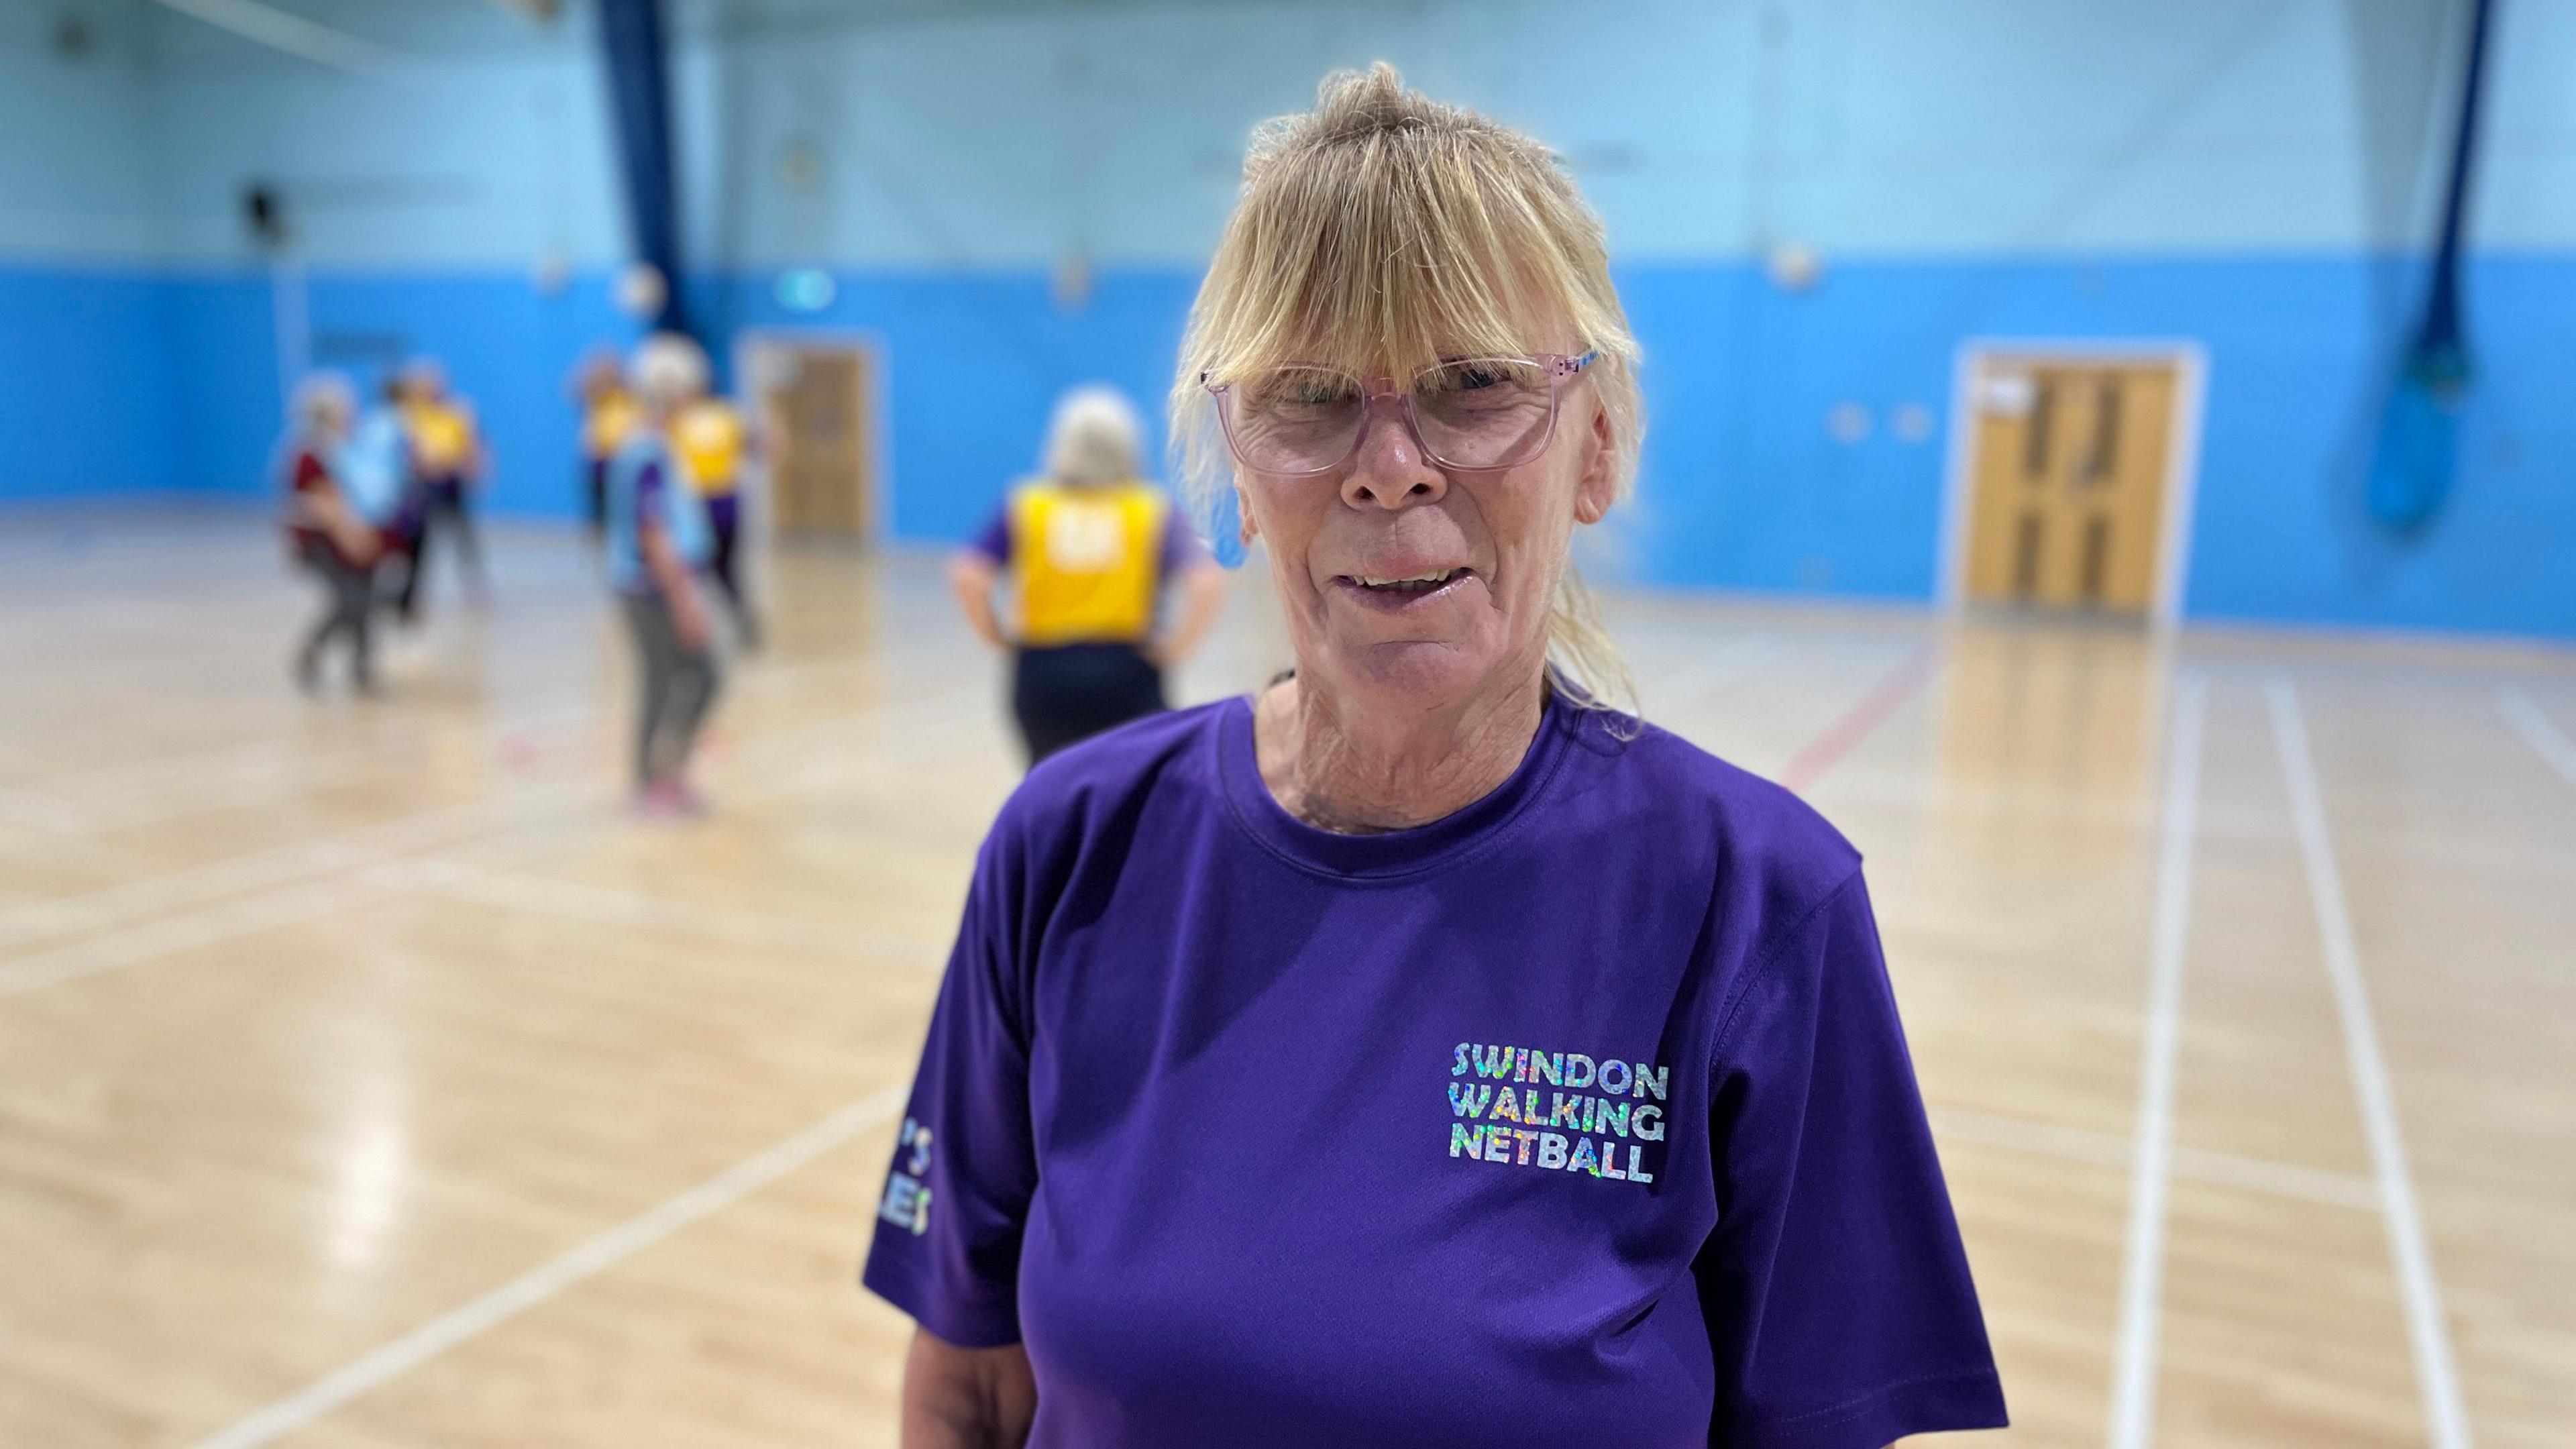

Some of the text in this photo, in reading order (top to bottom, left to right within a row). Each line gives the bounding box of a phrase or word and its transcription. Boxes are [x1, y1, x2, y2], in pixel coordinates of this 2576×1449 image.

[1452, 1042, 1669, 1100] SWINDON
[1448, 1082, 1665, 1141] WALKING
[1450, 1122, 1653, 1183] NETBALL
